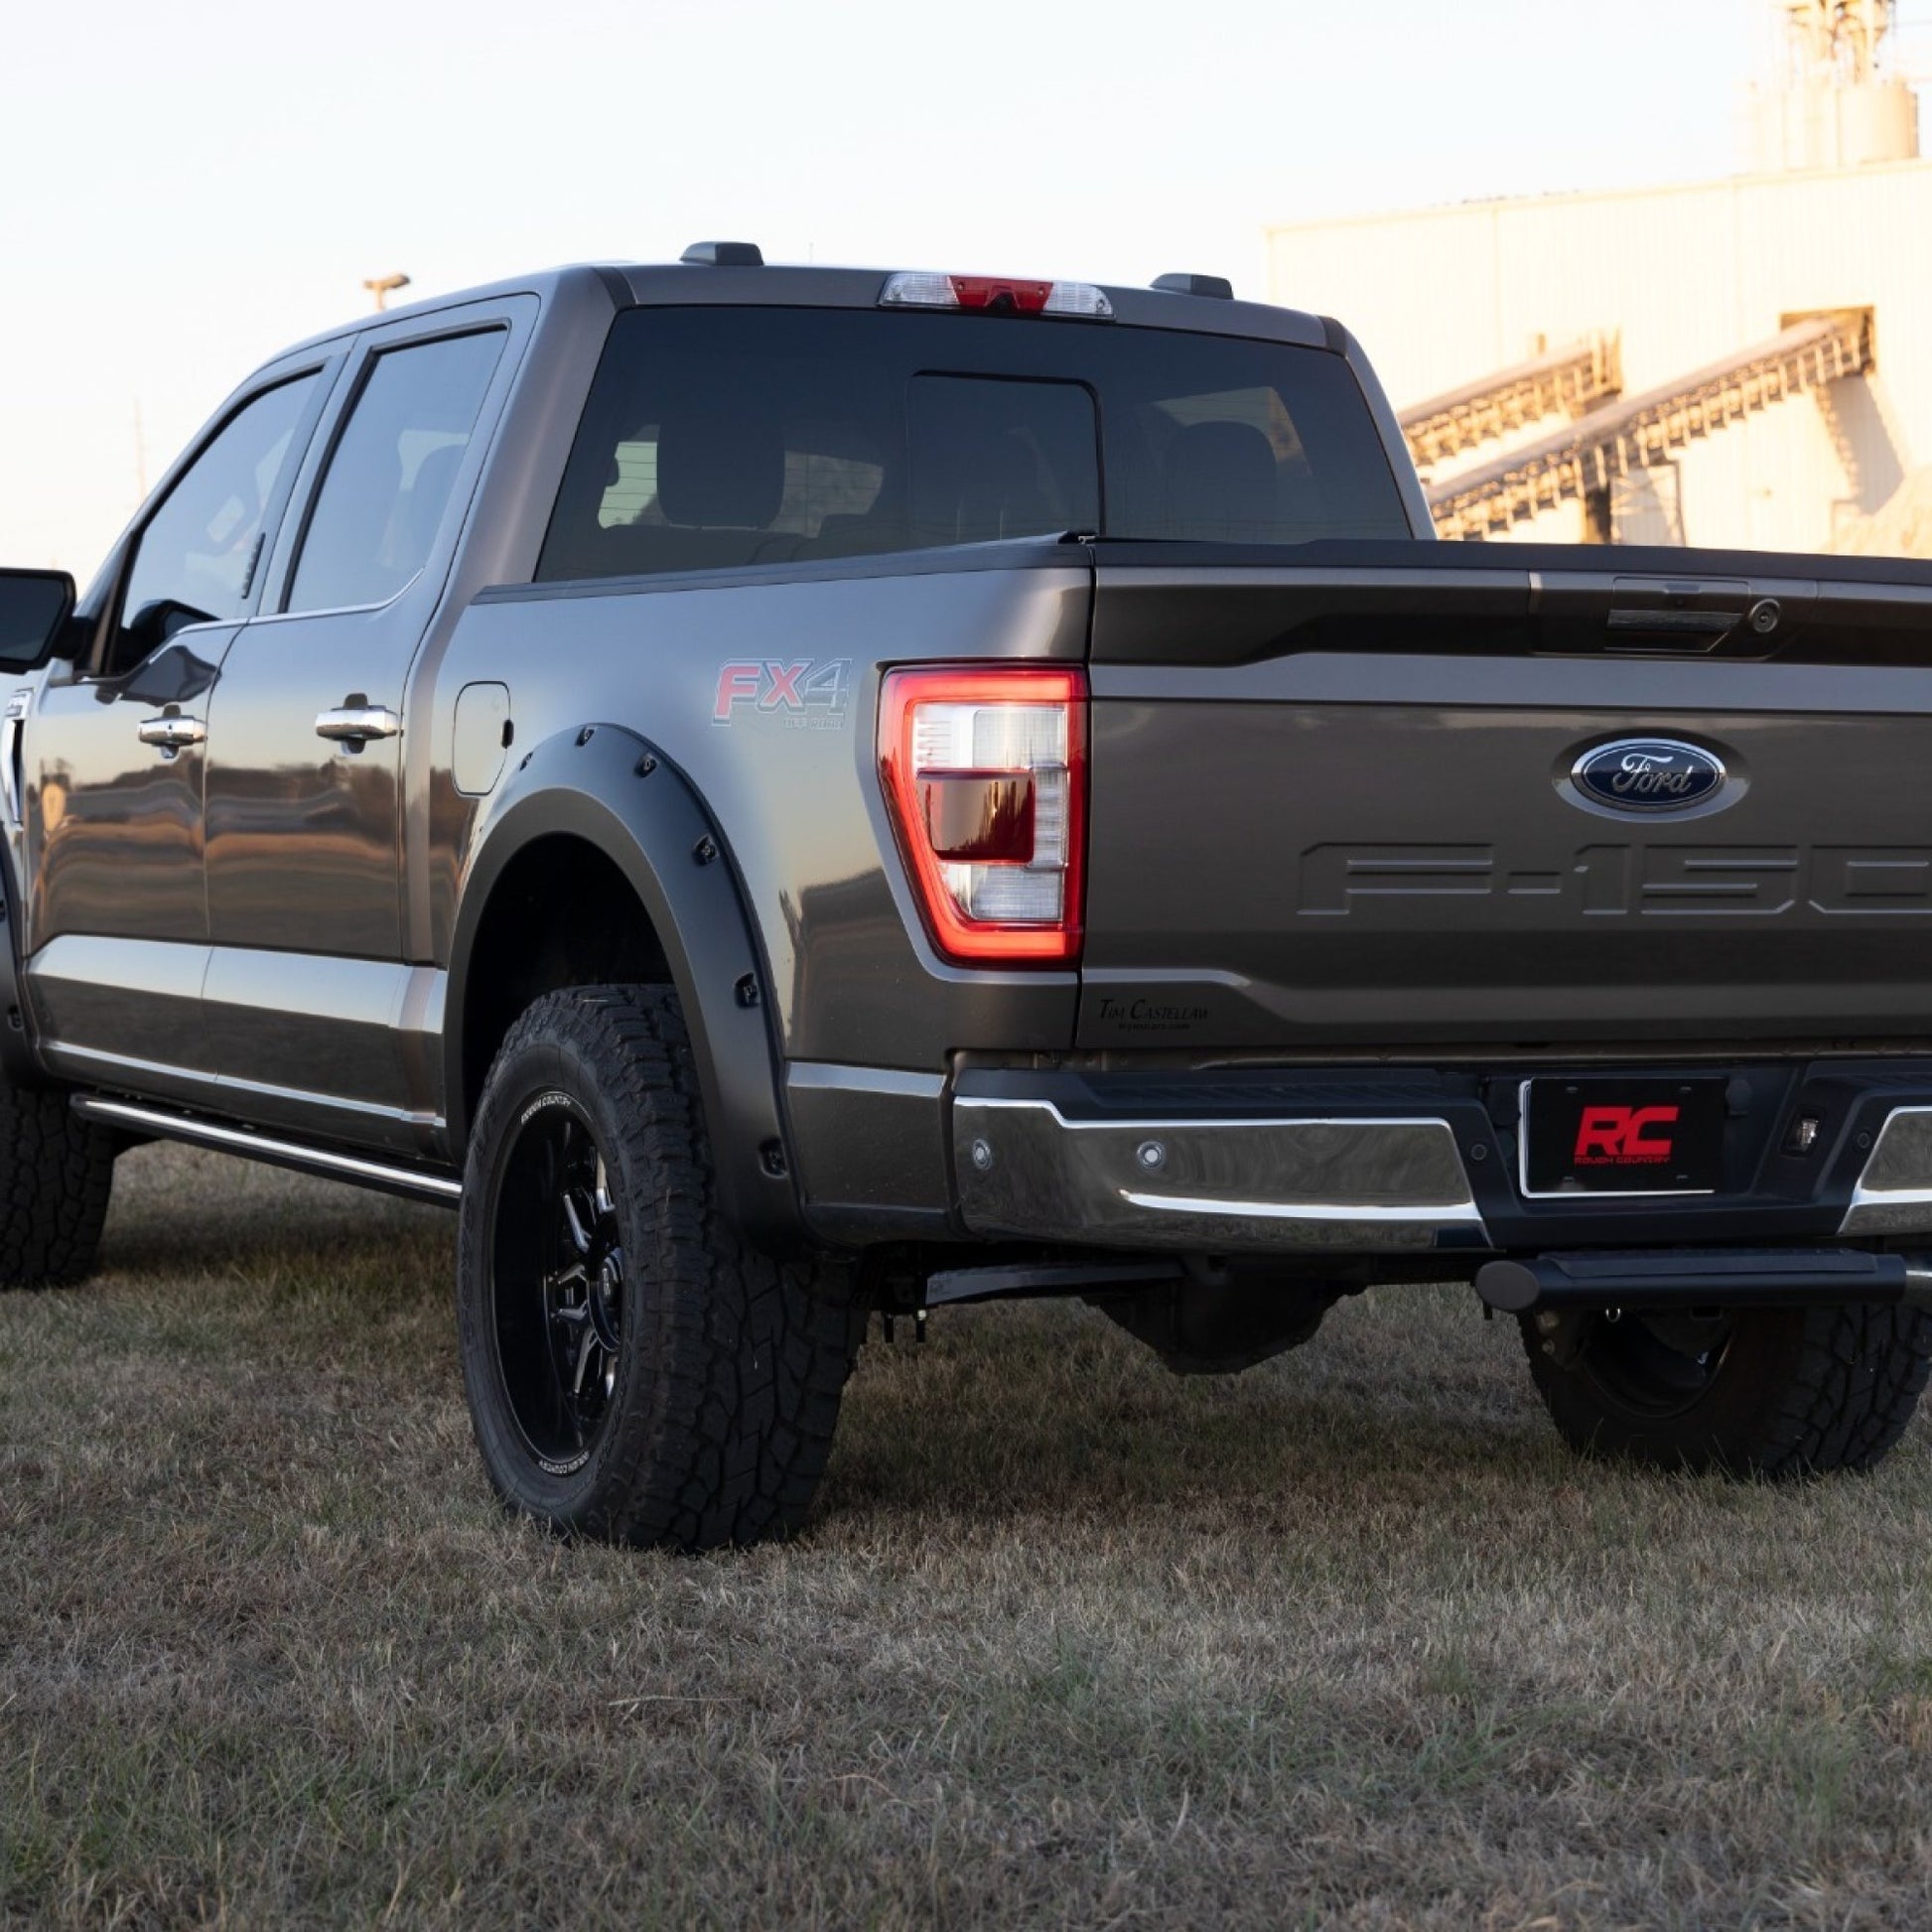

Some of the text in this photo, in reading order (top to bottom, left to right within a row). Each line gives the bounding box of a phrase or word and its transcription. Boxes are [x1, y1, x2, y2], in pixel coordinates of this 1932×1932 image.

[712, 658, 852, 726] FX4
[1612, 754, 1694, 792] Ford
[1298, 843, 1932, 913] F-150
[1575, 1107, 1679, 1155] RC
